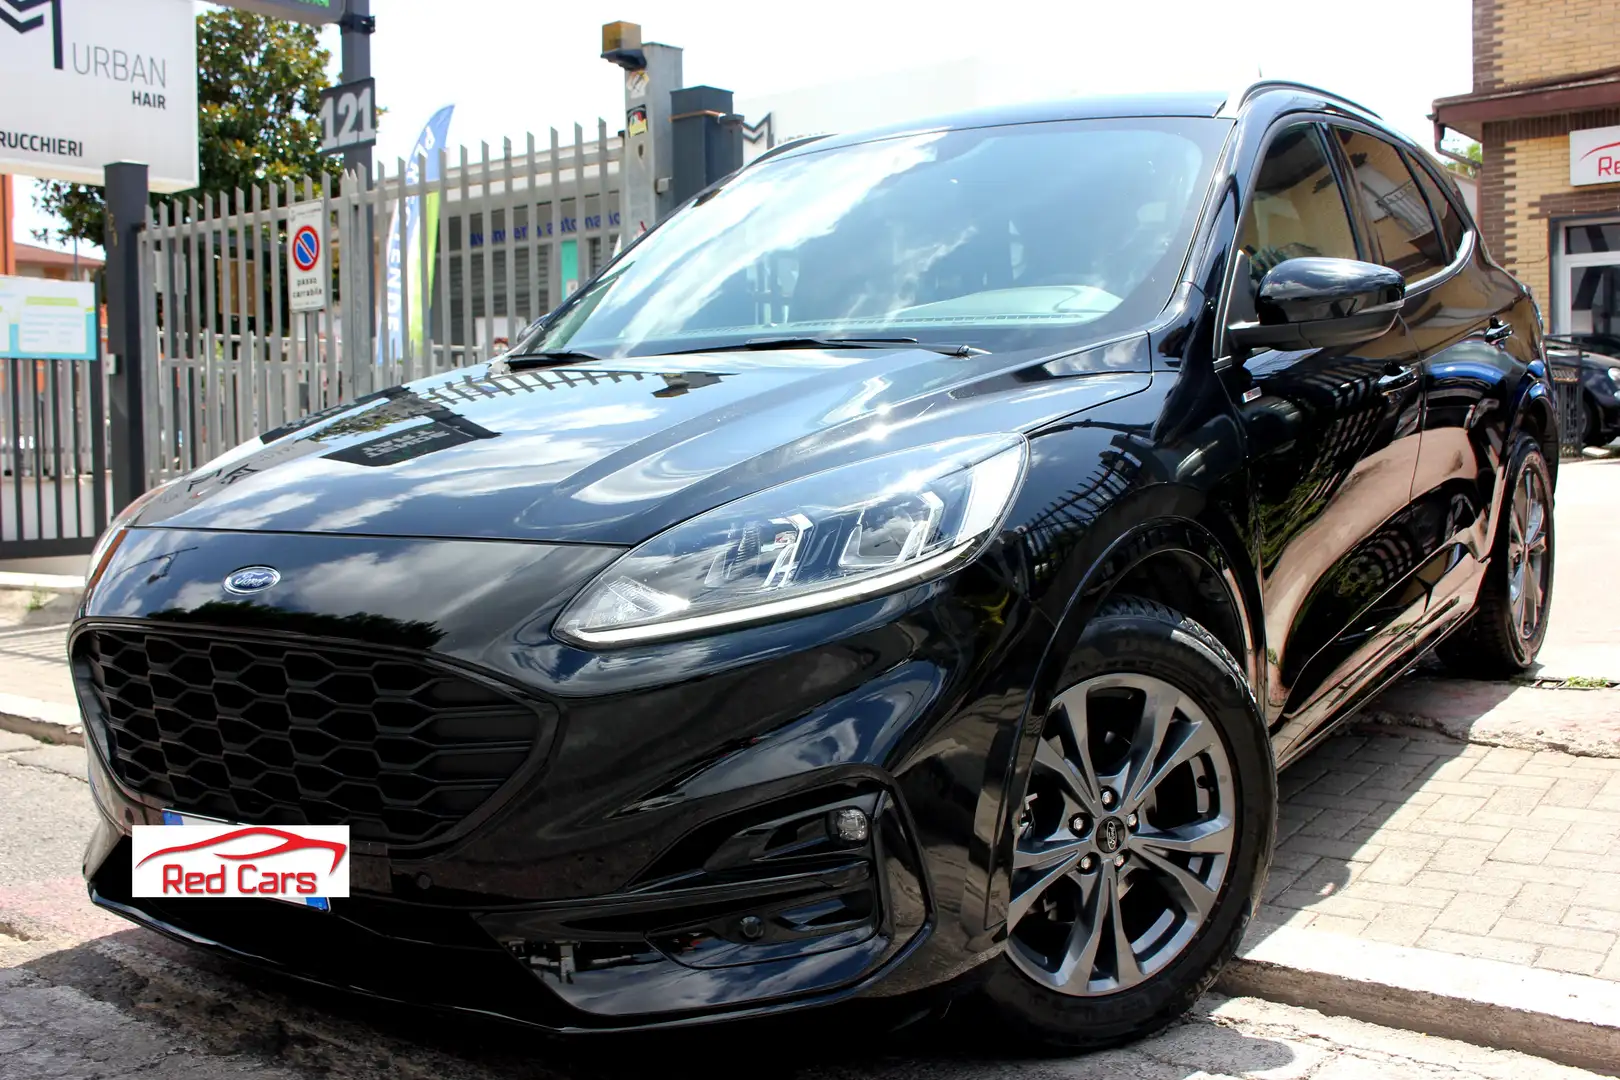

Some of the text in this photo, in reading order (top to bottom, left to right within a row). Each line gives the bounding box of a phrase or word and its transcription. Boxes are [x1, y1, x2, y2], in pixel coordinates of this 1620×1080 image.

[72, 42, 167, 89] URBAN
[131, 90, 167, 110] HAIR
[320, 86, 376, 149] 121
